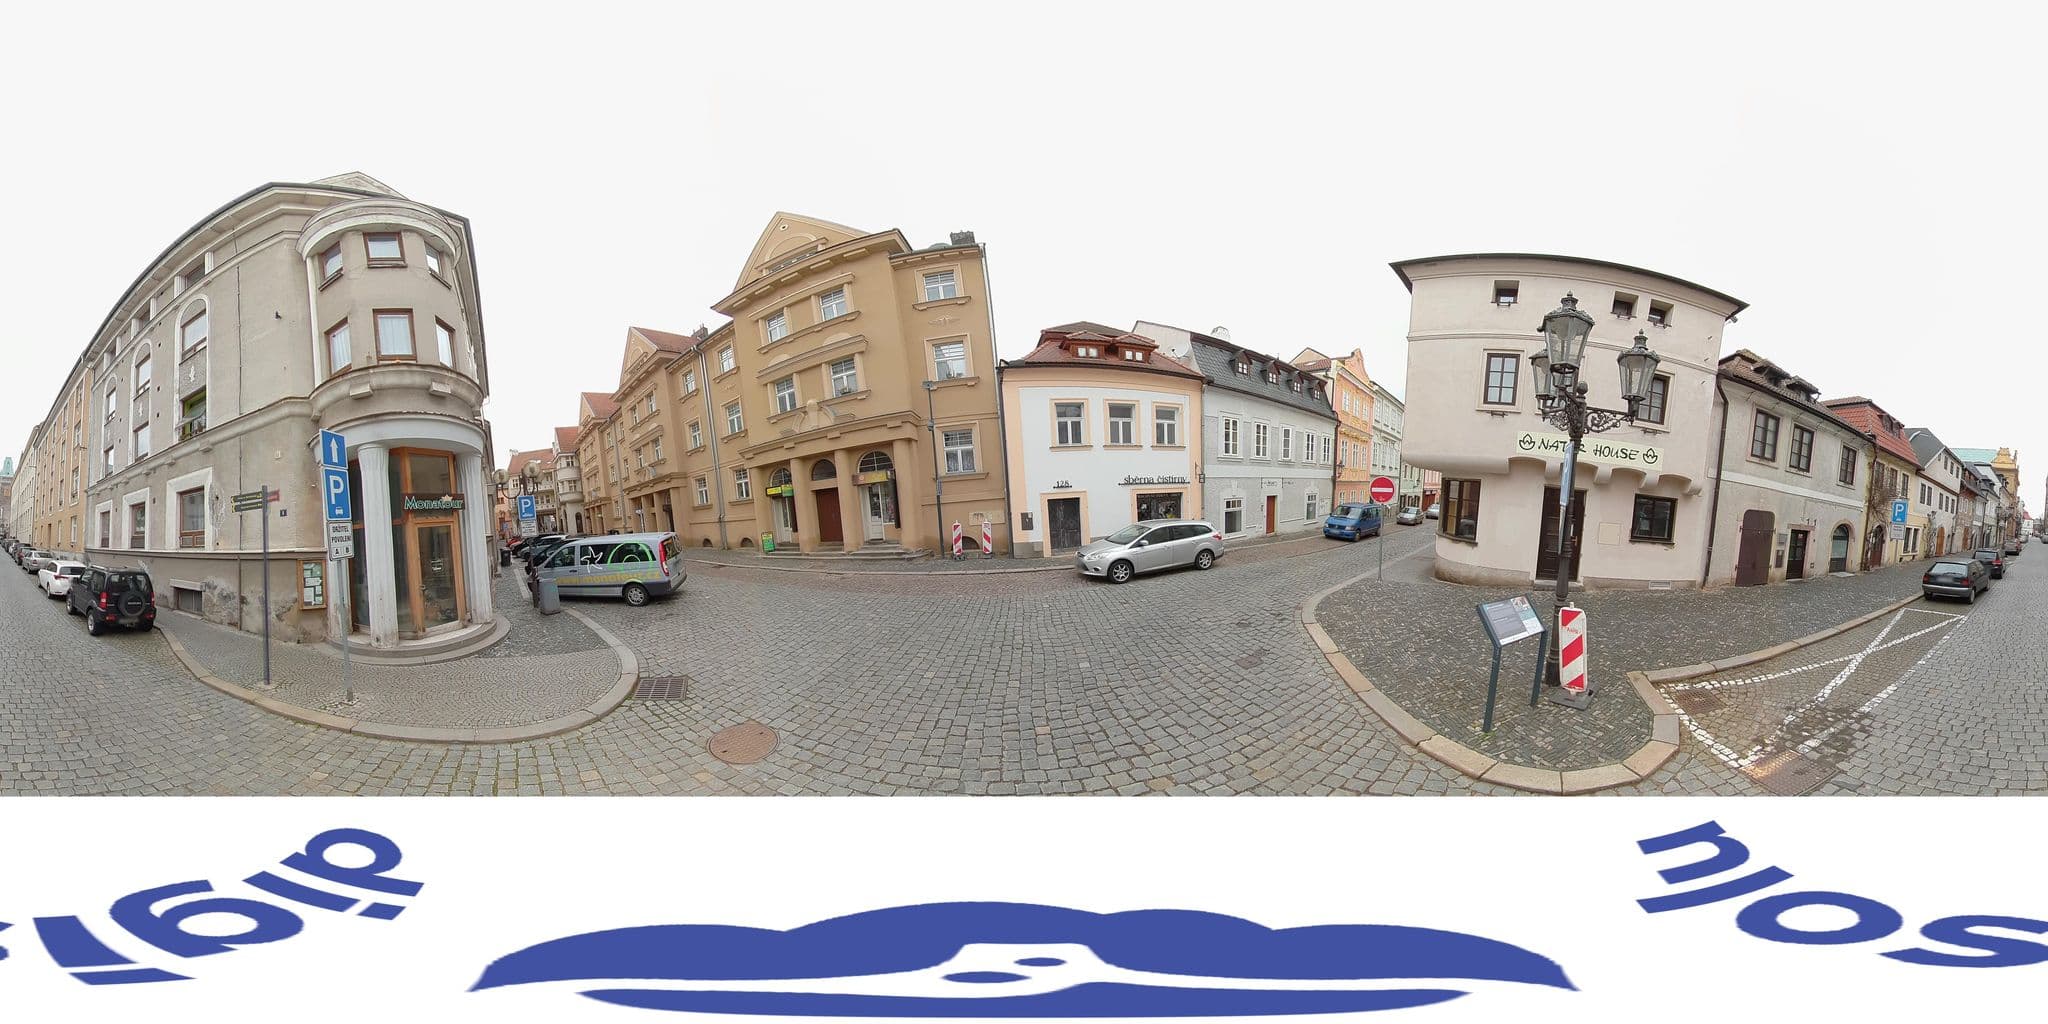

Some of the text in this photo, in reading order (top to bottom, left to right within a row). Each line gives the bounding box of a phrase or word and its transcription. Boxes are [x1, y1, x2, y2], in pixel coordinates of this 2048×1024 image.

[1538, 438, 1640, 460] NATR HOUSE
[329, 475, 344, 504] P
[404, 495, 464, 509] Monatour
[521, 499, 531, 513] P
[1895, 504, 1904, 517] P
